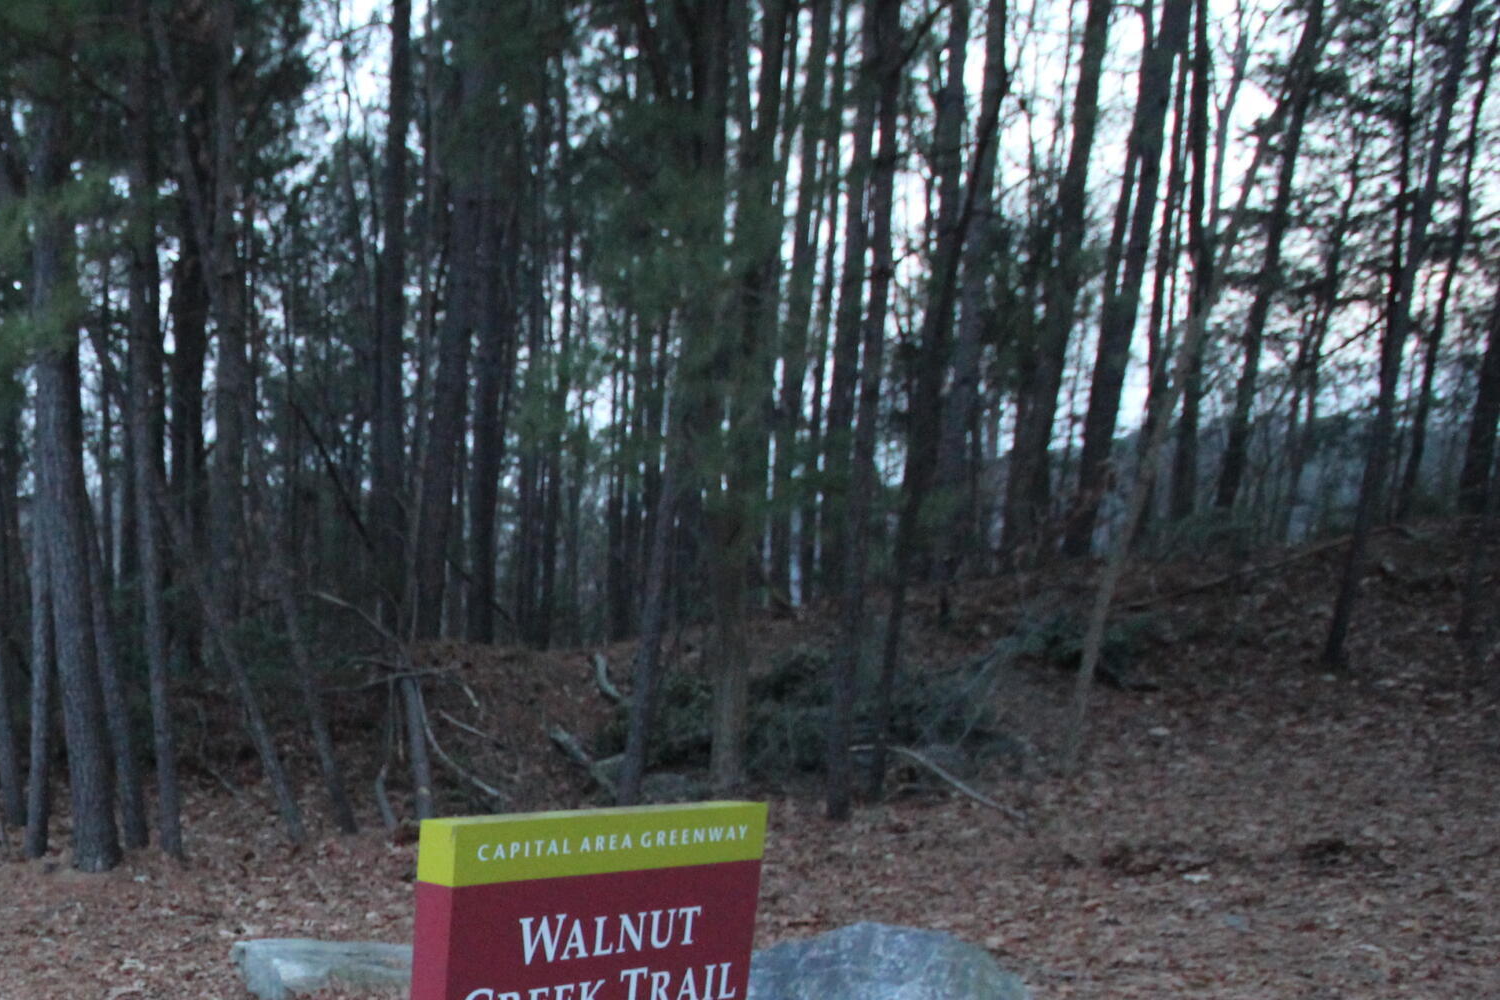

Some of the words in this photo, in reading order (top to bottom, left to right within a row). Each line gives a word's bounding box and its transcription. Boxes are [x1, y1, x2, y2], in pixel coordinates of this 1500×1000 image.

[477, 838, 572, 862] CAPITAL
[580, 833, 633, 853] AREA
[640, 824, 748, 848] GREENWAY
[518, 905, 702, 966] WALNUT
